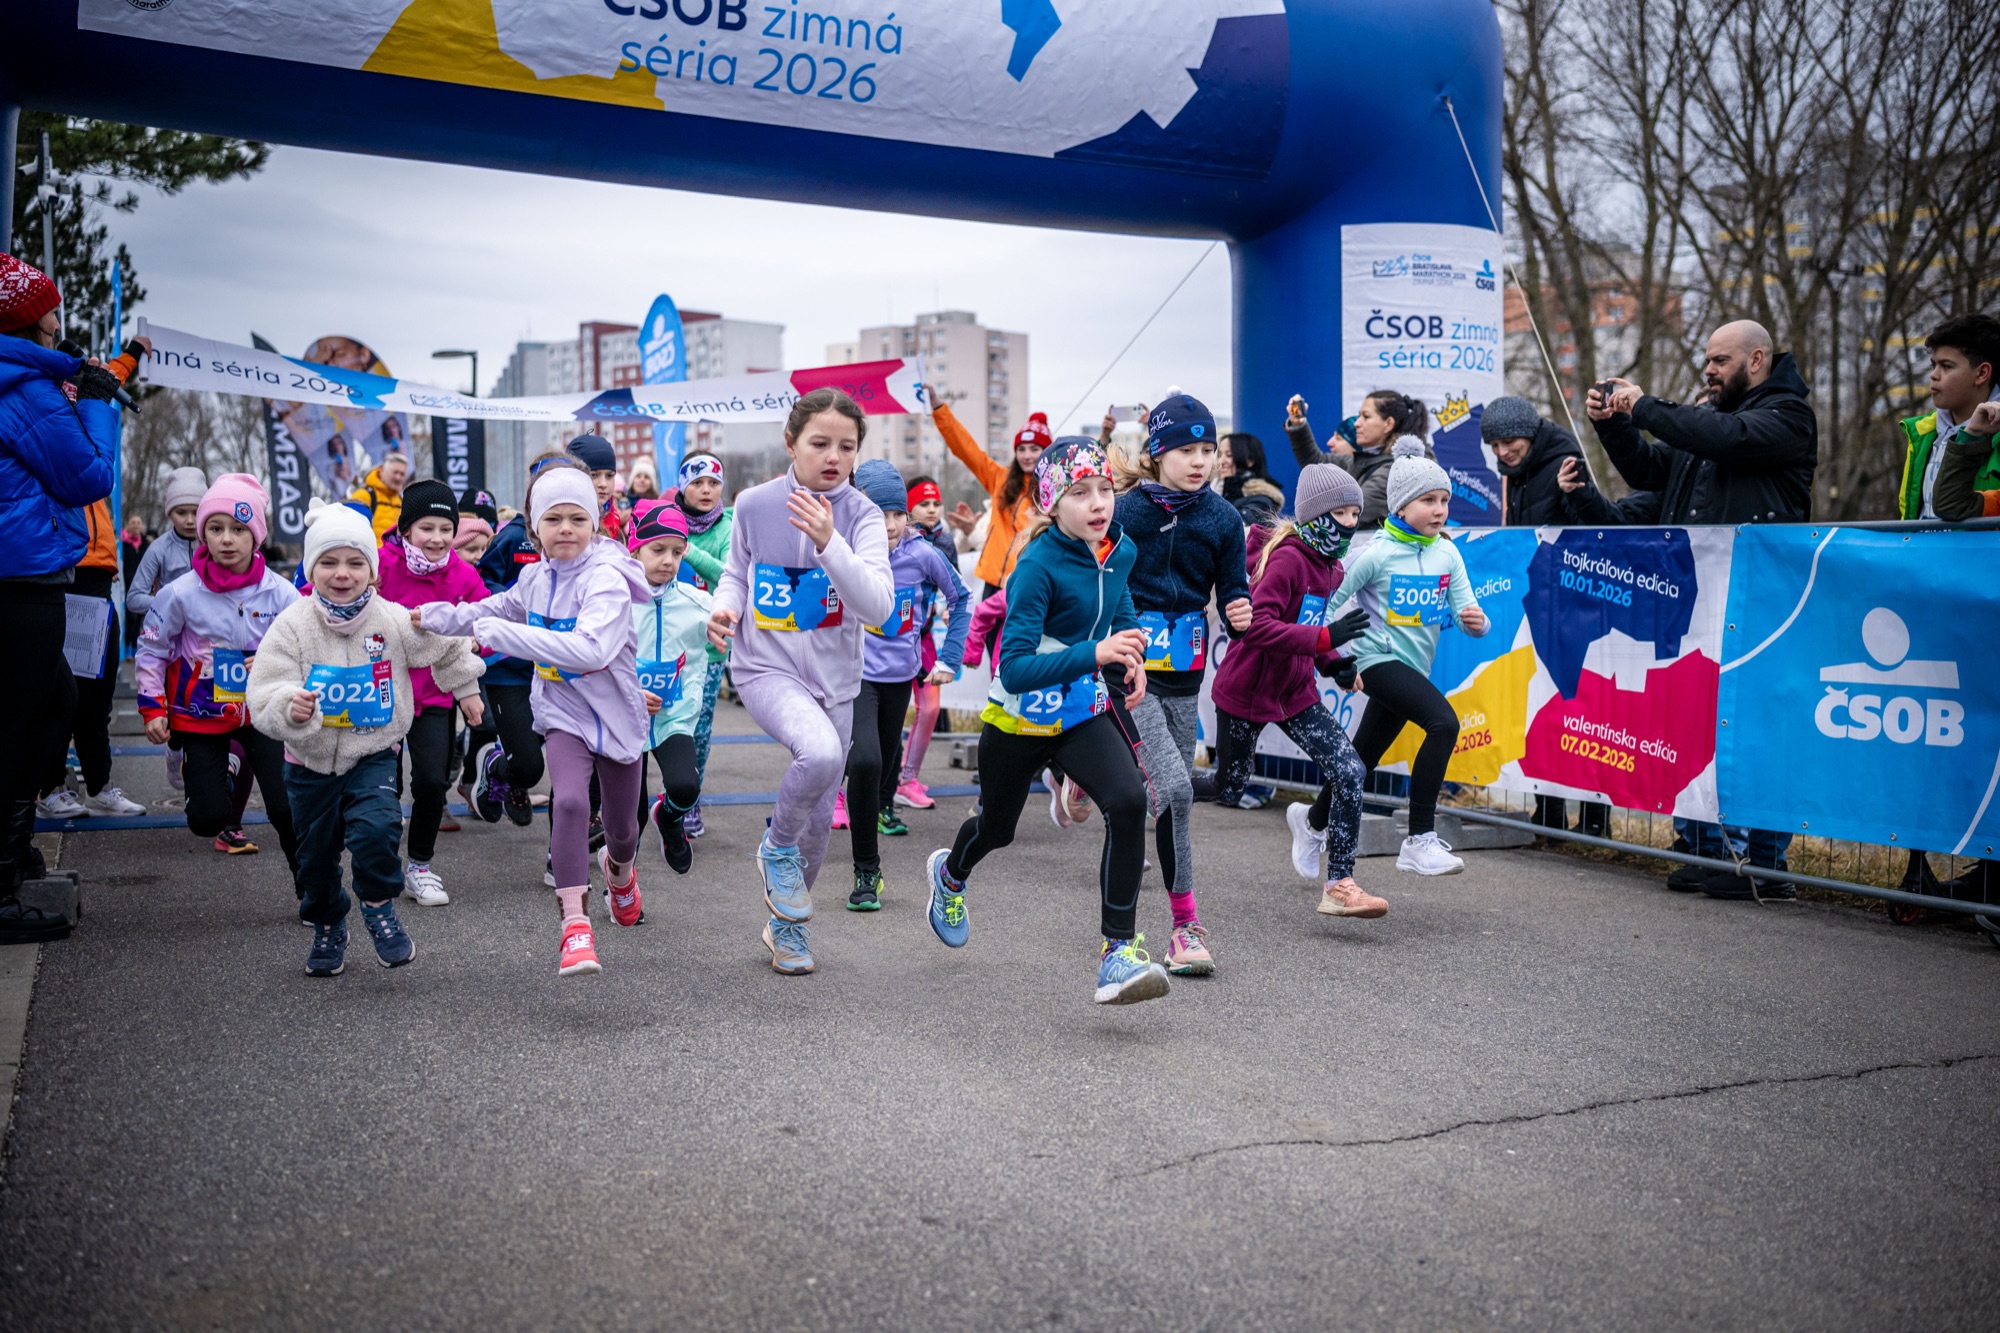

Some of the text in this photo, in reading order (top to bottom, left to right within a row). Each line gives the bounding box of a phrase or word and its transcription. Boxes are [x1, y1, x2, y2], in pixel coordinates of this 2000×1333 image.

[762, 0, 902, 55] zimná
[619, 33, 877, 103] séria 2026
[1475, 277, 1495, 291] ČSOB
[1365, 309, 1498, 344] ČSOB zimná
[1378, 344, 1494, 372] séria 2026
[212, 357, 281, 385] séria
[290, 373, 364, 399] 2026
[593, 402, 666, 417] ČSOB
[673, 396, 746, 415] zimná
[1563, 549, 1679, 598] trojkráľová edícia
[758, 581, 791, 607] 23
[1393, 588, 1439, 605] 3005
[1475, 577, 1512, 599] edícia
[1560, 569, 1633, 607] 10.01.2026
[1301, 609, 1322, 626] 26
[218, 663, 247, 683] 10
[638, 672, 676, 689] 057
[311, 681, 376, 703] 3022
[1026, 691, 1063, 714] 29
[1459, 710, 1485, 730] dícia
[1814, 685, 1965, 747] ČSOB
[1563, 715, 1677, 764] valentínska edícia
[1560, 733, 1635, 773] 07.02.2026
